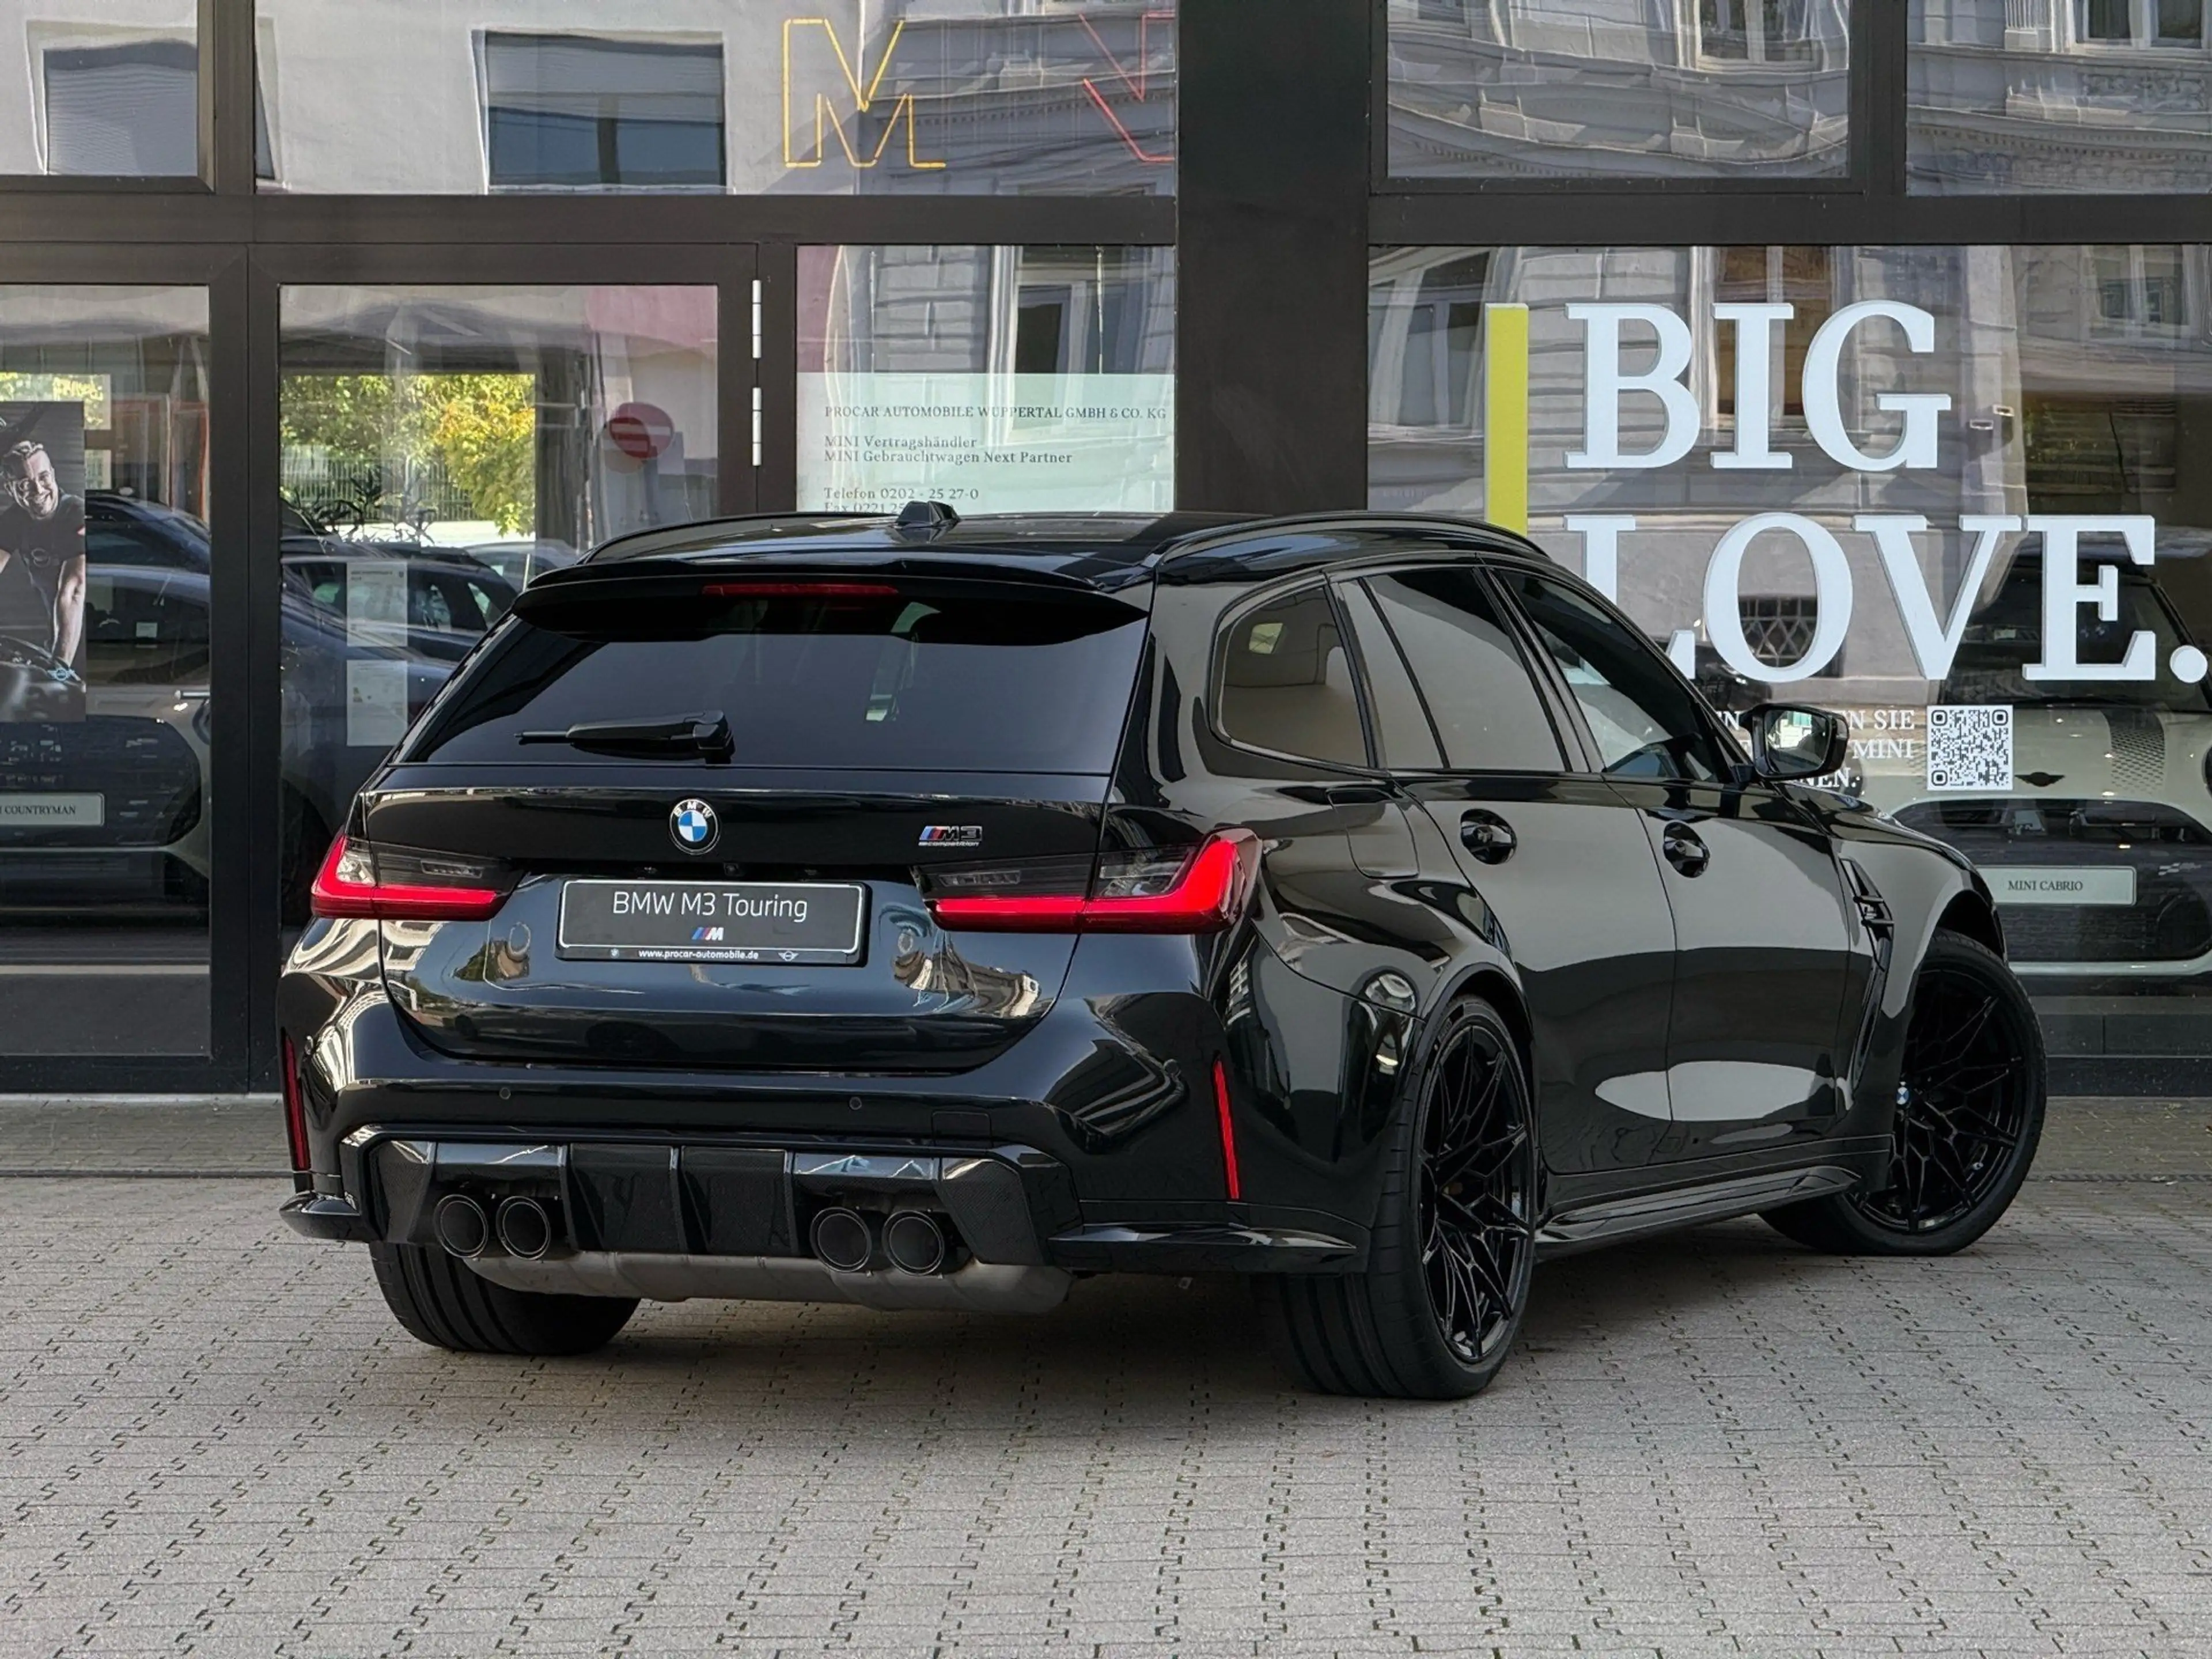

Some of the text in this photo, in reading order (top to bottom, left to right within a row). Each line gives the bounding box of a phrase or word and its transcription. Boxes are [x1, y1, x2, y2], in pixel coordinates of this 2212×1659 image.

[1564, 300, 1951, 471] BIG
[825, 406, 1166, 419] PROCAR AUTOMOBILE WUPPERTAL GMBH & CO. KG
[824, 435, 978, 450] MINI Vertragshändler
[824, 450, 1073, 465] MINI Gebrauchtwagen Next Partner
[824, 487, 876, 499] Telefon
[880, 488, 915, 499] 0202
[929, 488, 944, 499] 25
[950, 488, 979, 499] 27-0
[825, 502, 849, 513] Fax
[1873, 710, 1914, 730] SIE
[1851, 739, 1914, 759] MINI
[5, 805, 76, 815] COUNTRYMAN
[2008, 880, 2084, 892] MINI CABRIO
[612, 891, 808, 923] BMW M3 Touring
[638, 949, 759, 960] www.procar-automobile.de
